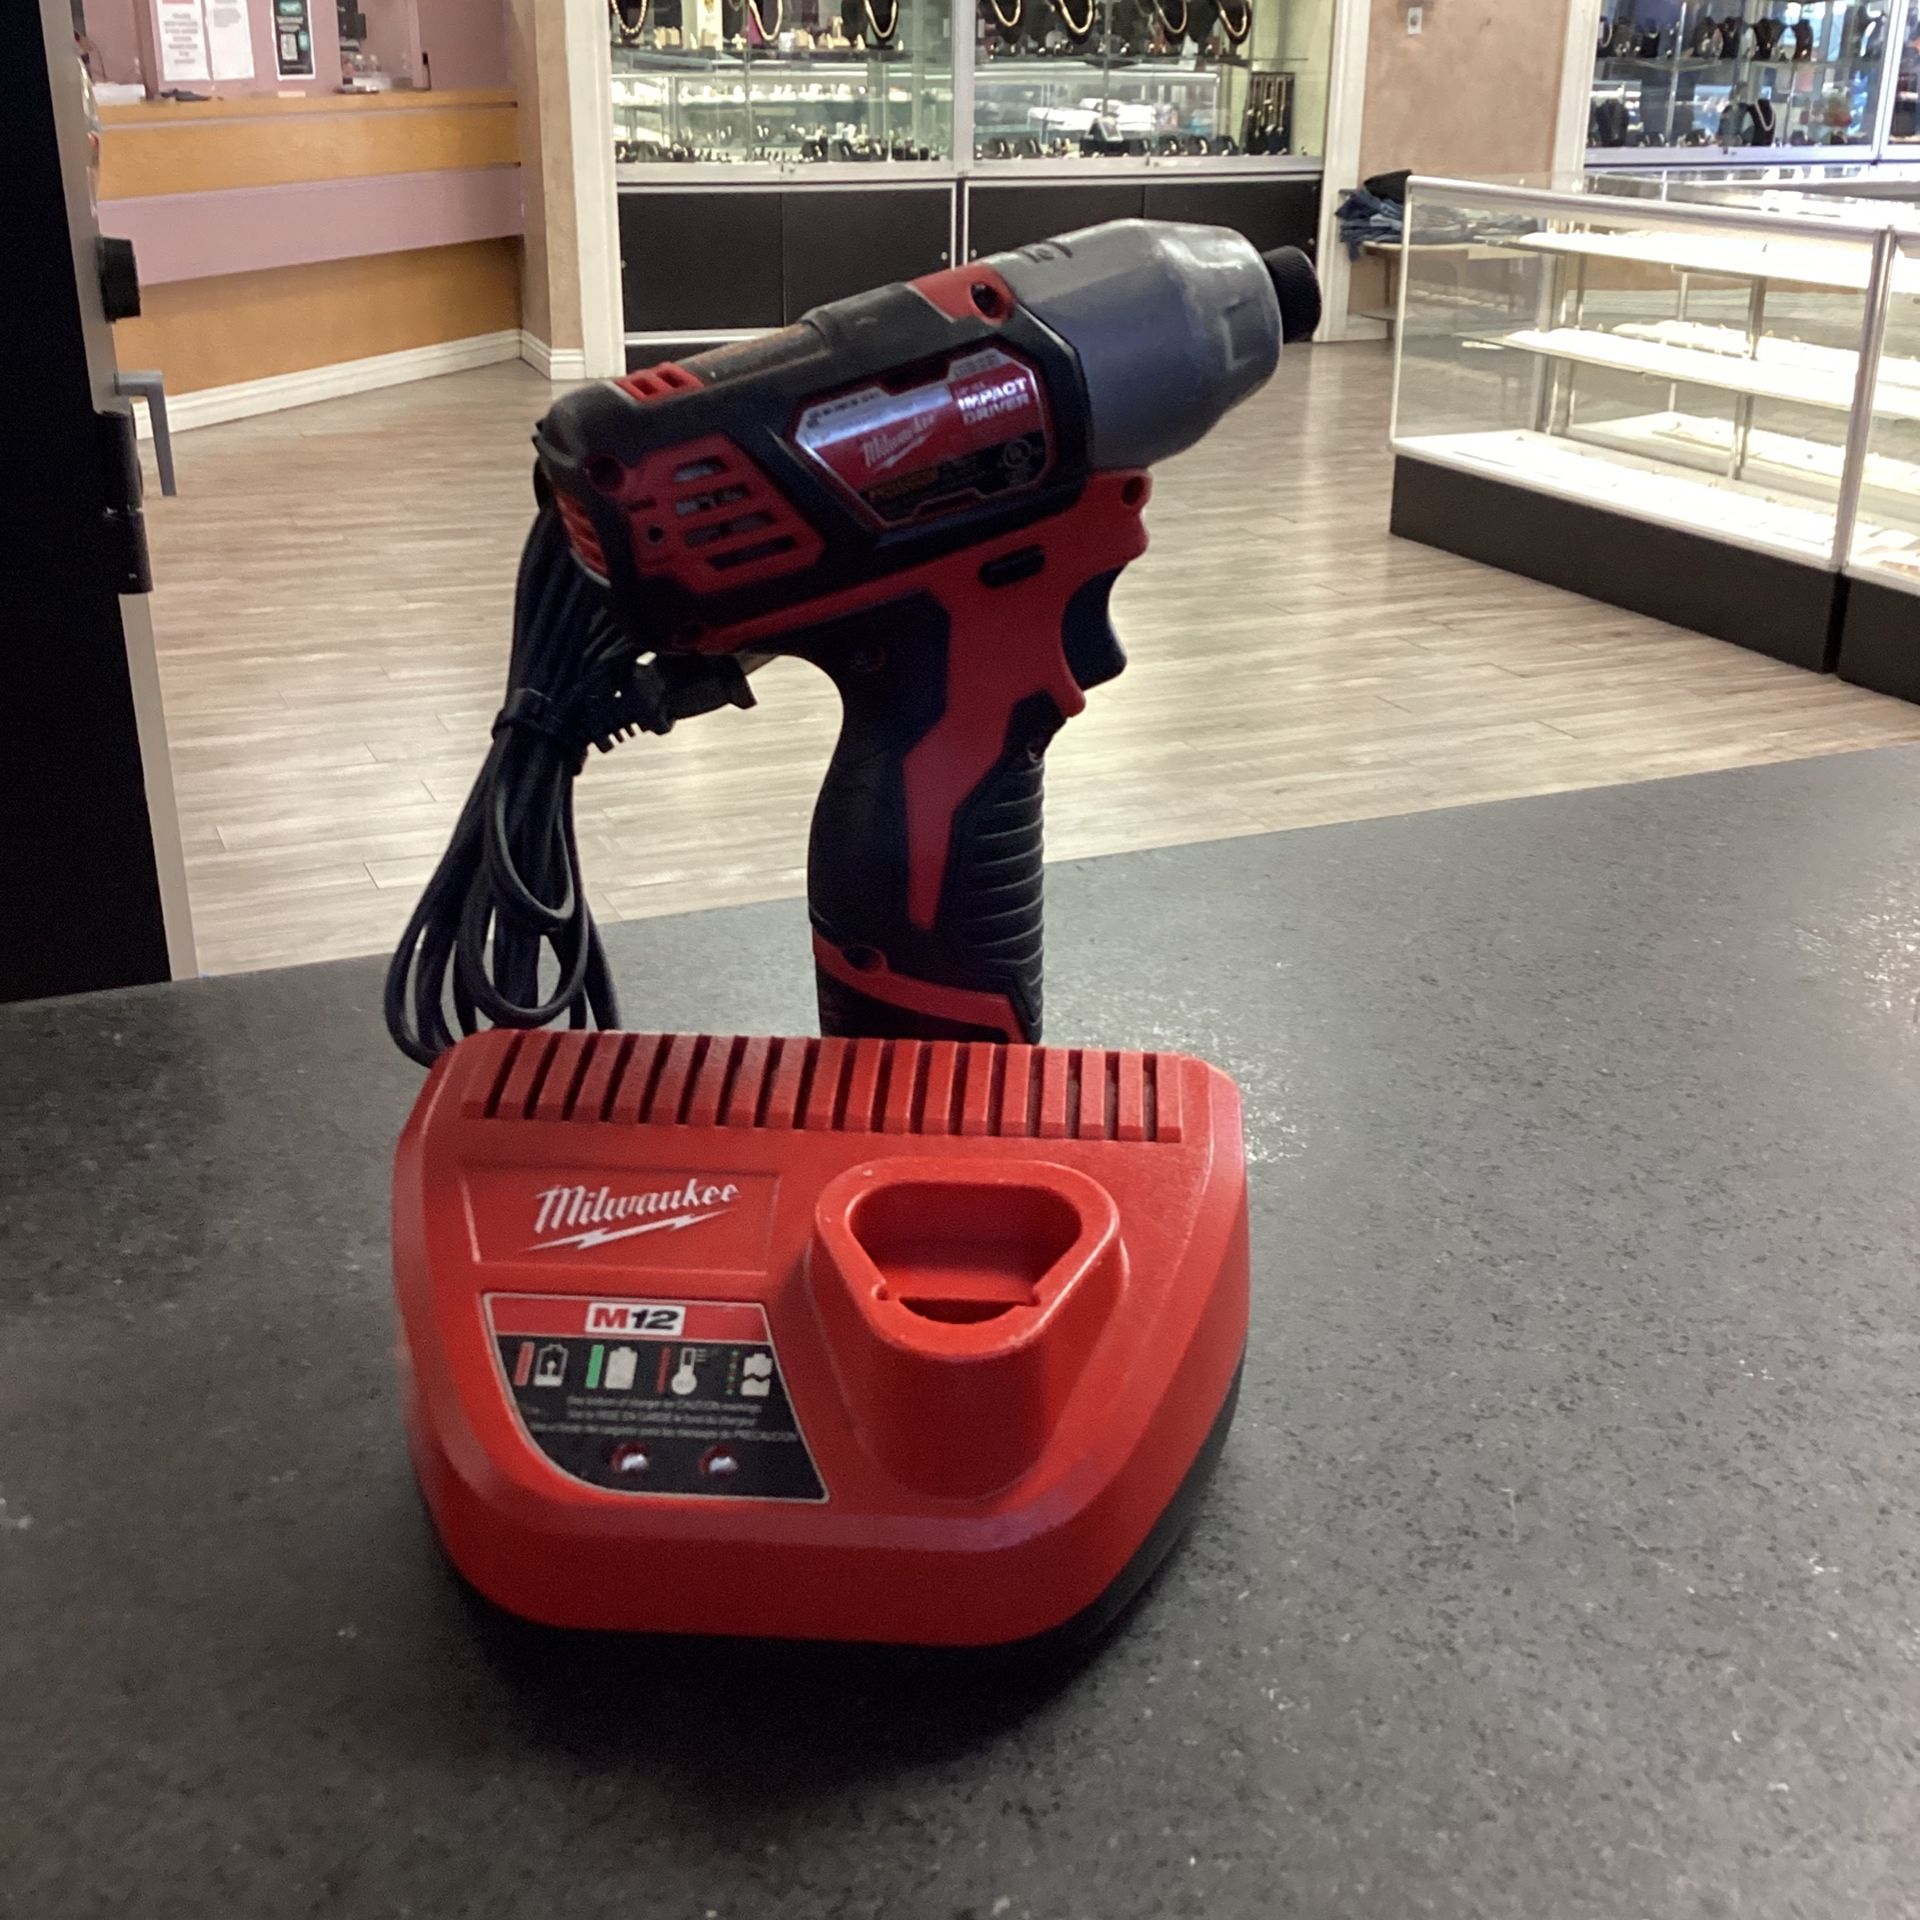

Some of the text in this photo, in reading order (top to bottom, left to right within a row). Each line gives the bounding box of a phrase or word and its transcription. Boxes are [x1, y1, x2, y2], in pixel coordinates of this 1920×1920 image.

[957, 376, 1027, 411] IMPACT
[963, 393, 1030, 426] DRIVER
[534, 1177, 742, 1234] Milwaukee
[592, 1307, 680, 1331] M12
